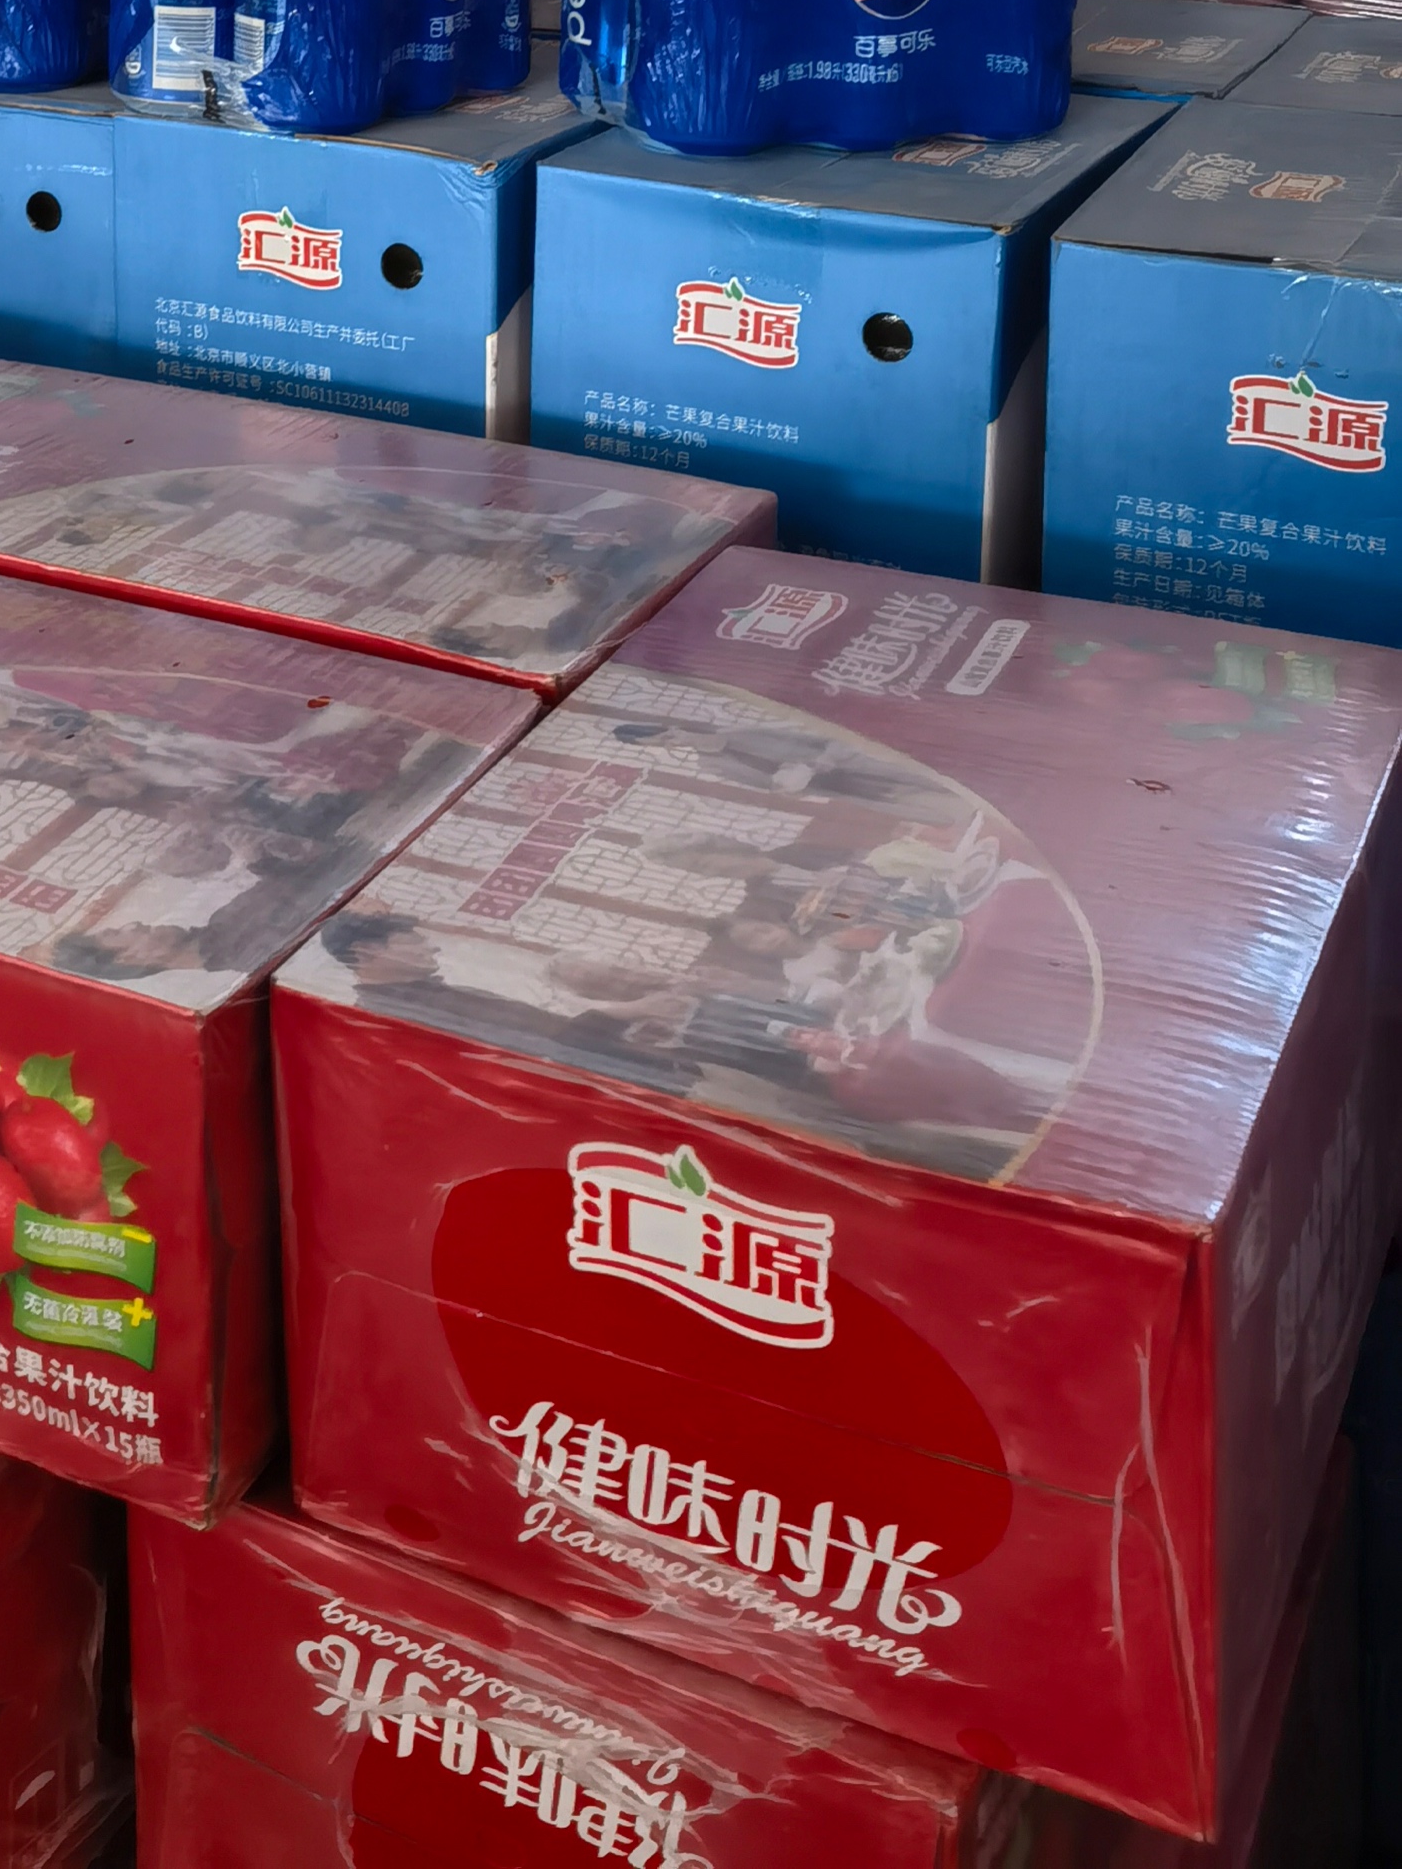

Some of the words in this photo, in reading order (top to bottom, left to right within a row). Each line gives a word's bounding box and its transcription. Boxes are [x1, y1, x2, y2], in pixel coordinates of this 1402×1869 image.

[241, 227, 340, 273] 汇源
[676, 299, 799, 350] 汇源
[1229, 394, 1387, 452] 汇源
[573, 1179, 830, 1311] 汇源
[489, 1401, 962, 1633] 健味时光
[296, 1633, 714, 1869] 健味时光
